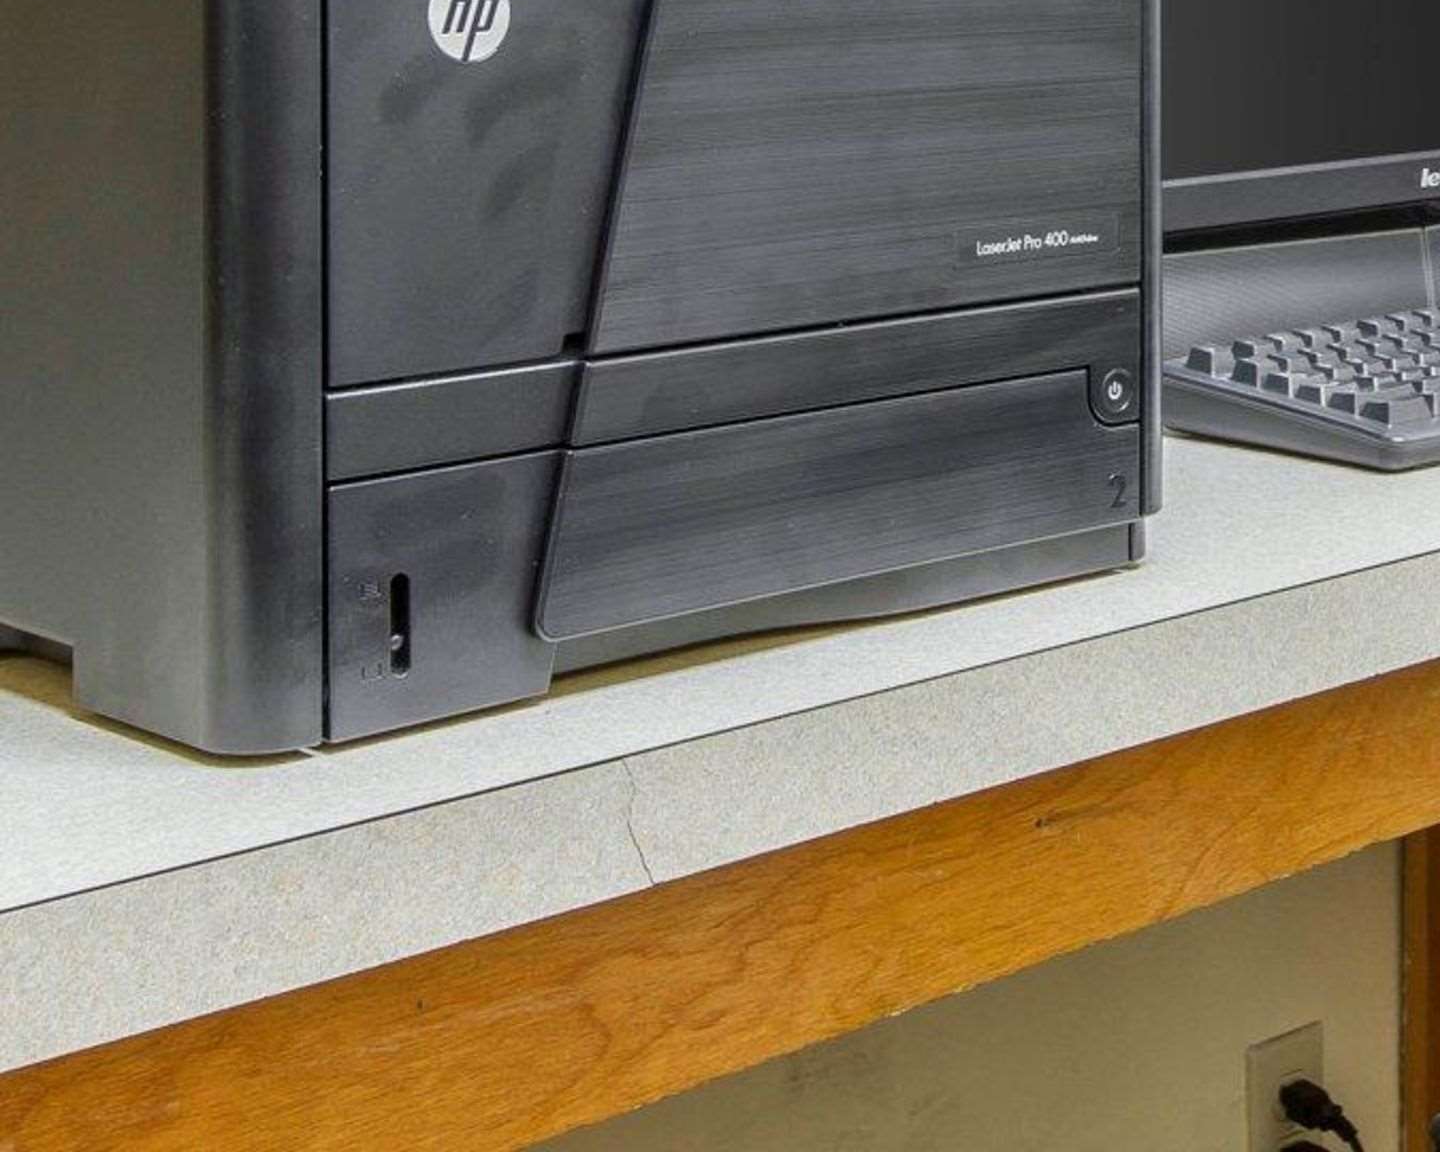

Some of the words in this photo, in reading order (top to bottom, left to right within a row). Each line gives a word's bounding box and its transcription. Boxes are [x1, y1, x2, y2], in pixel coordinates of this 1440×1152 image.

[976, 237, 1022, 256] LaserJet
[1023, 234, 1042, 250] Pro
[1043, 230, 1069, 247] 400
[1107, 473, 1127, 508] 2
